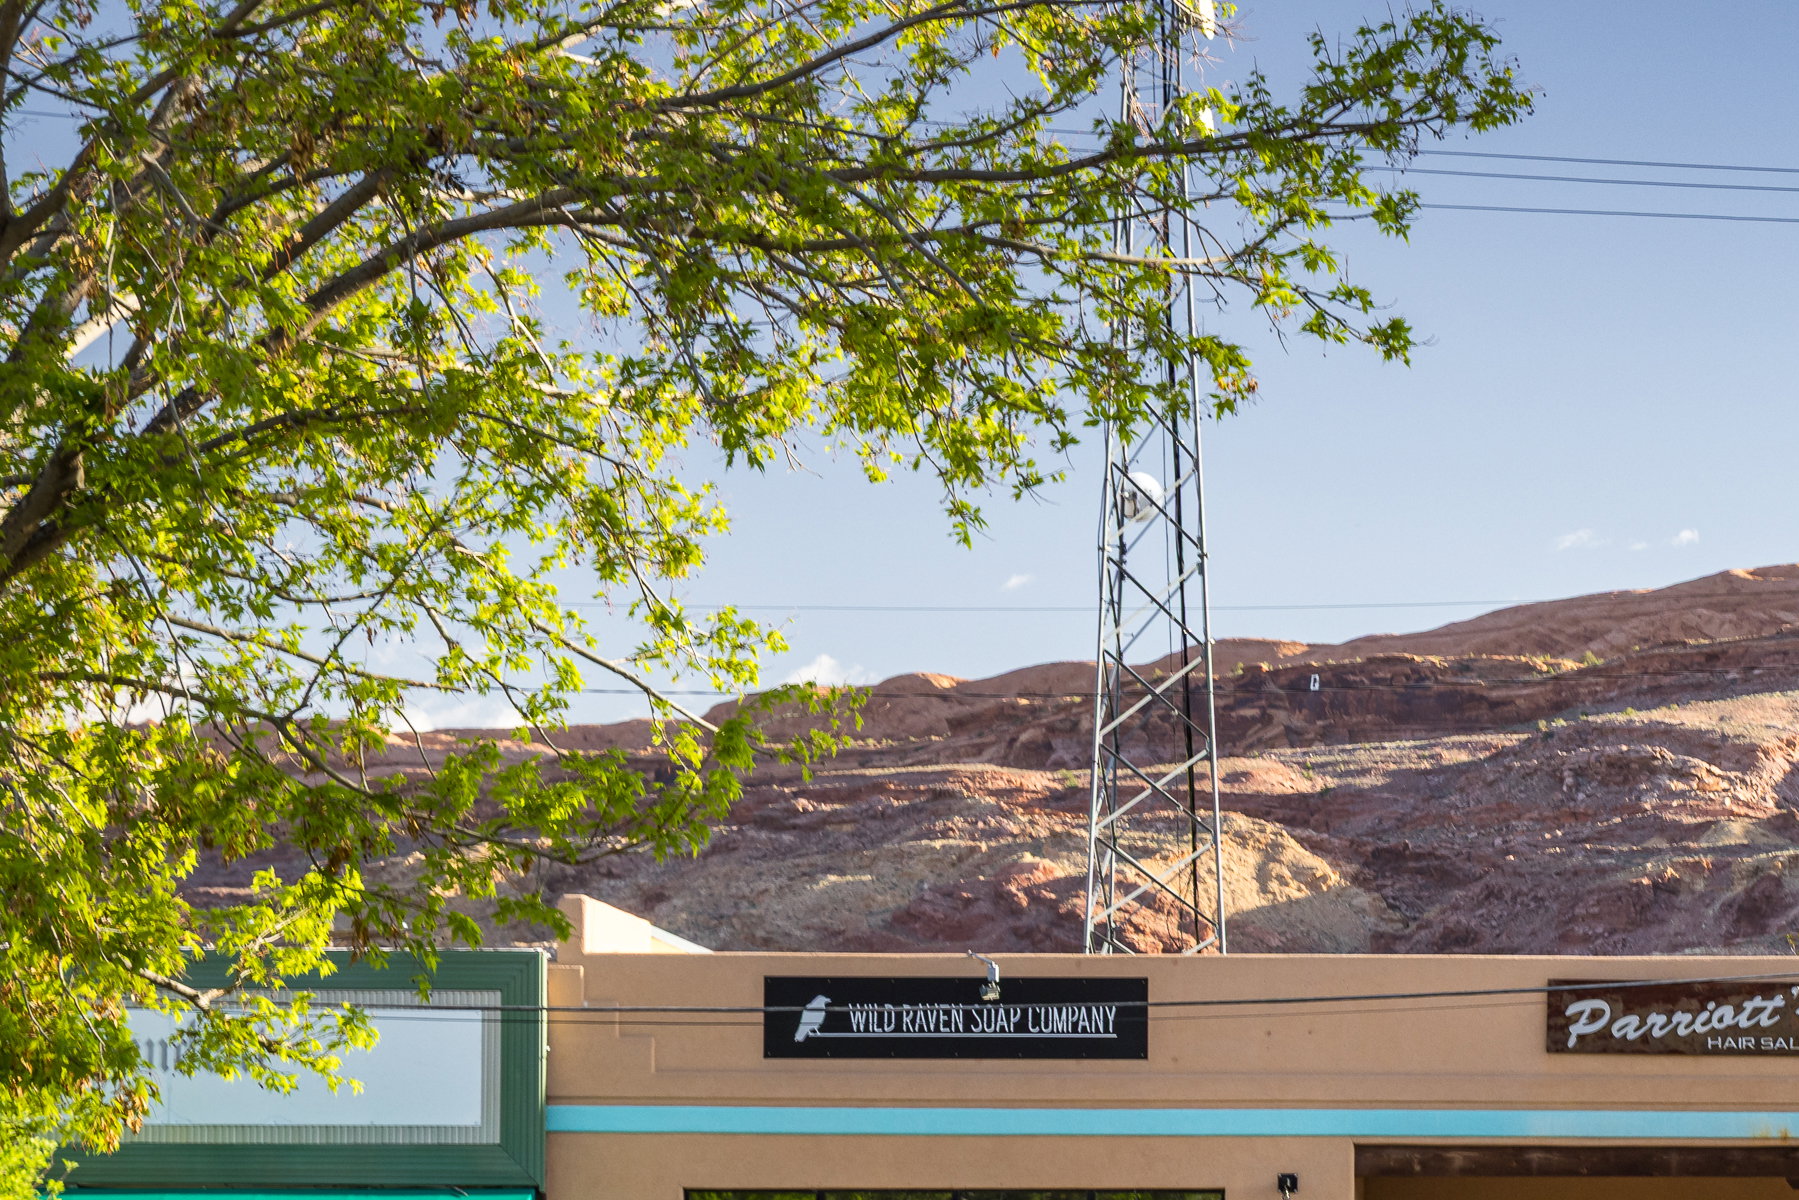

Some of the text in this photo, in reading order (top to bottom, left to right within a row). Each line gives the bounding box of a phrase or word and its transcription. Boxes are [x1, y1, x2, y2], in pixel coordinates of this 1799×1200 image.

[848, 1003, 1116, 1034] WILD RAVEN SOAP COMPANY
[1707, 1037, 1755, 1050] HAIR
